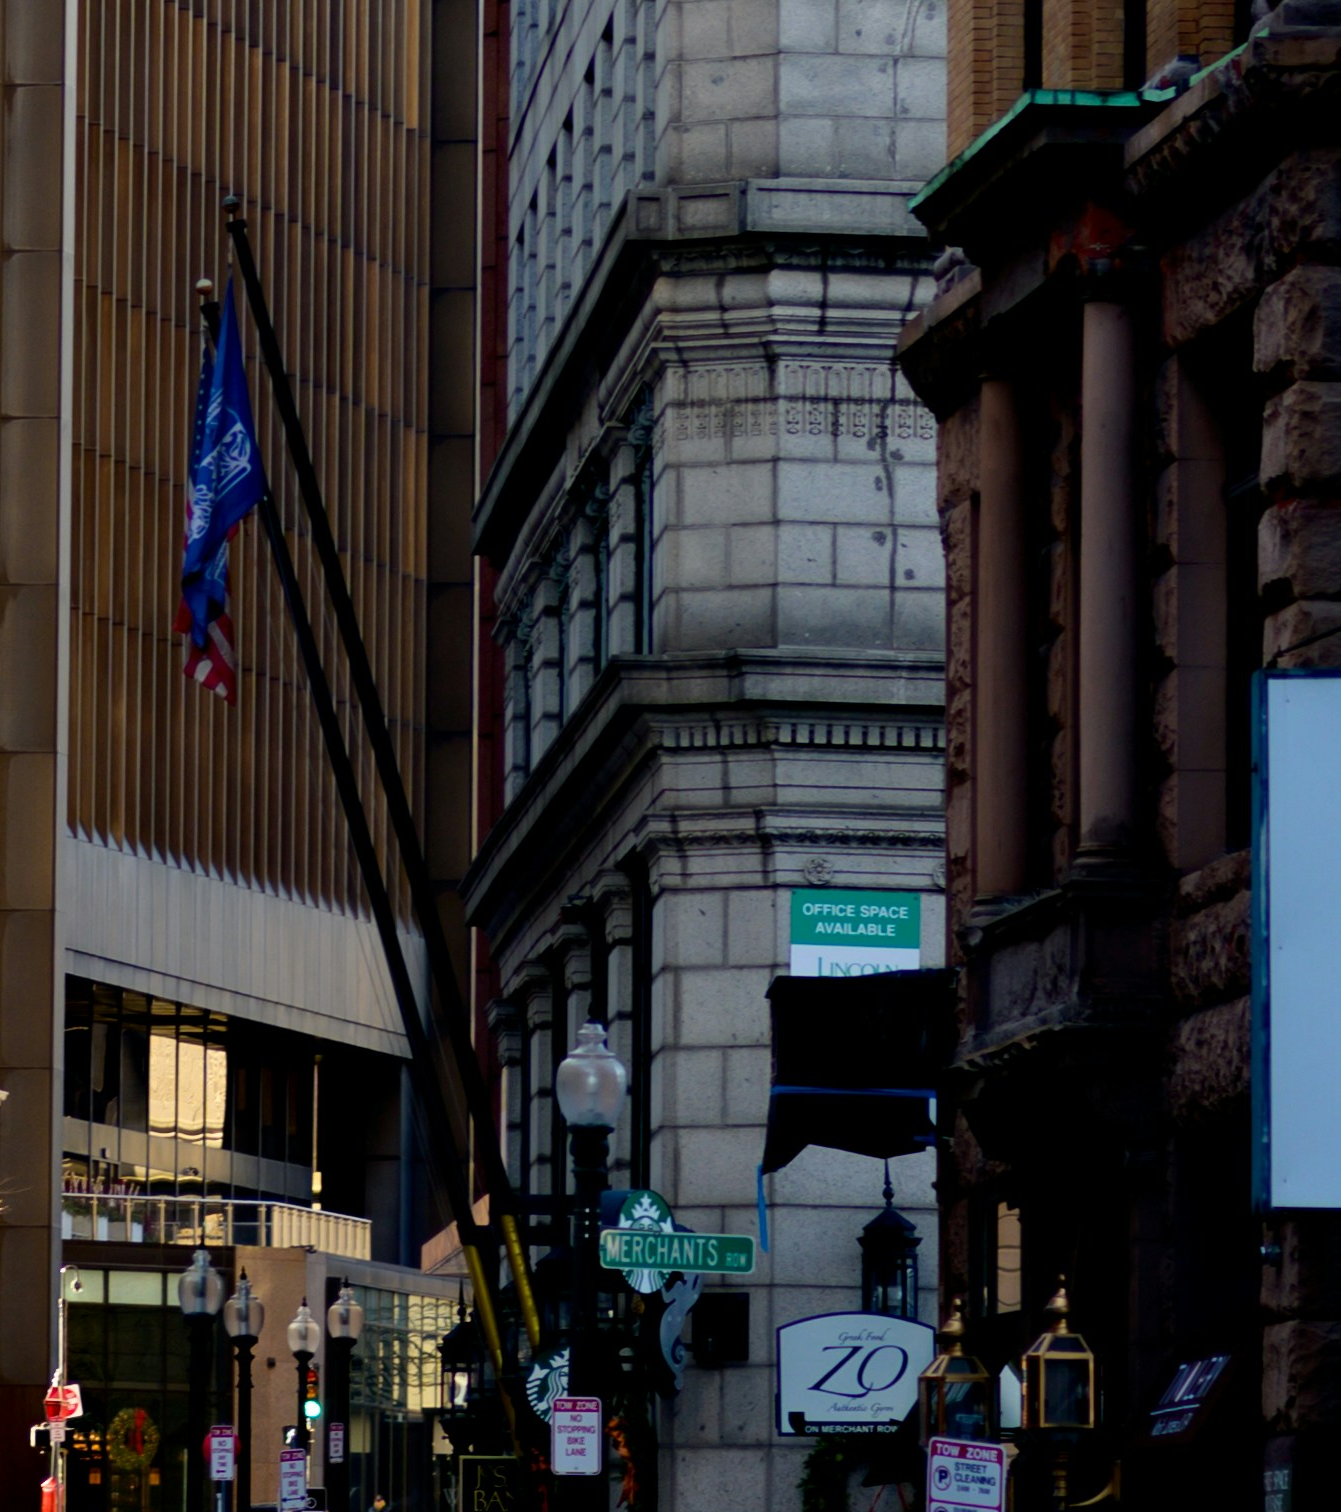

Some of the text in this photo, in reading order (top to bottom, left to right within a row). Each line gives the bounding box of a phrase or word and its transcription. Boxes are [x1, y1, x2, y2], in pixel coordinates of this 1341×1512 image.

[802, 902, 909, 919] OFFICE SPACE
[815, 922, 896, 936] AVAILABLE
[606, 1235, 747, 1267] MERCHANTS ROW
[838, 1328, 892, 1344] Greek Food
[807, 1344, 909, 1398] ZO
[556, 1400, 597, 1411] TOW ZONE
[827, 1399, 866, 1413] Authentic
[570, 1414, 582, 1423] NO
[557, 1425, 596, 1434] STOPPING
[805, 1425, 819, 1433] ON
[821, 1425, 875, 1433] MERCHANT
[567, 1436, 585, 1445] BIKE
[566, 1448, 586, 1457] LANE
[935, 1443, 999, 1461] TOW ZONE
[954, 1461, 988, 1474] STREET
[954, 1473, 997, 1487] CLEANING
